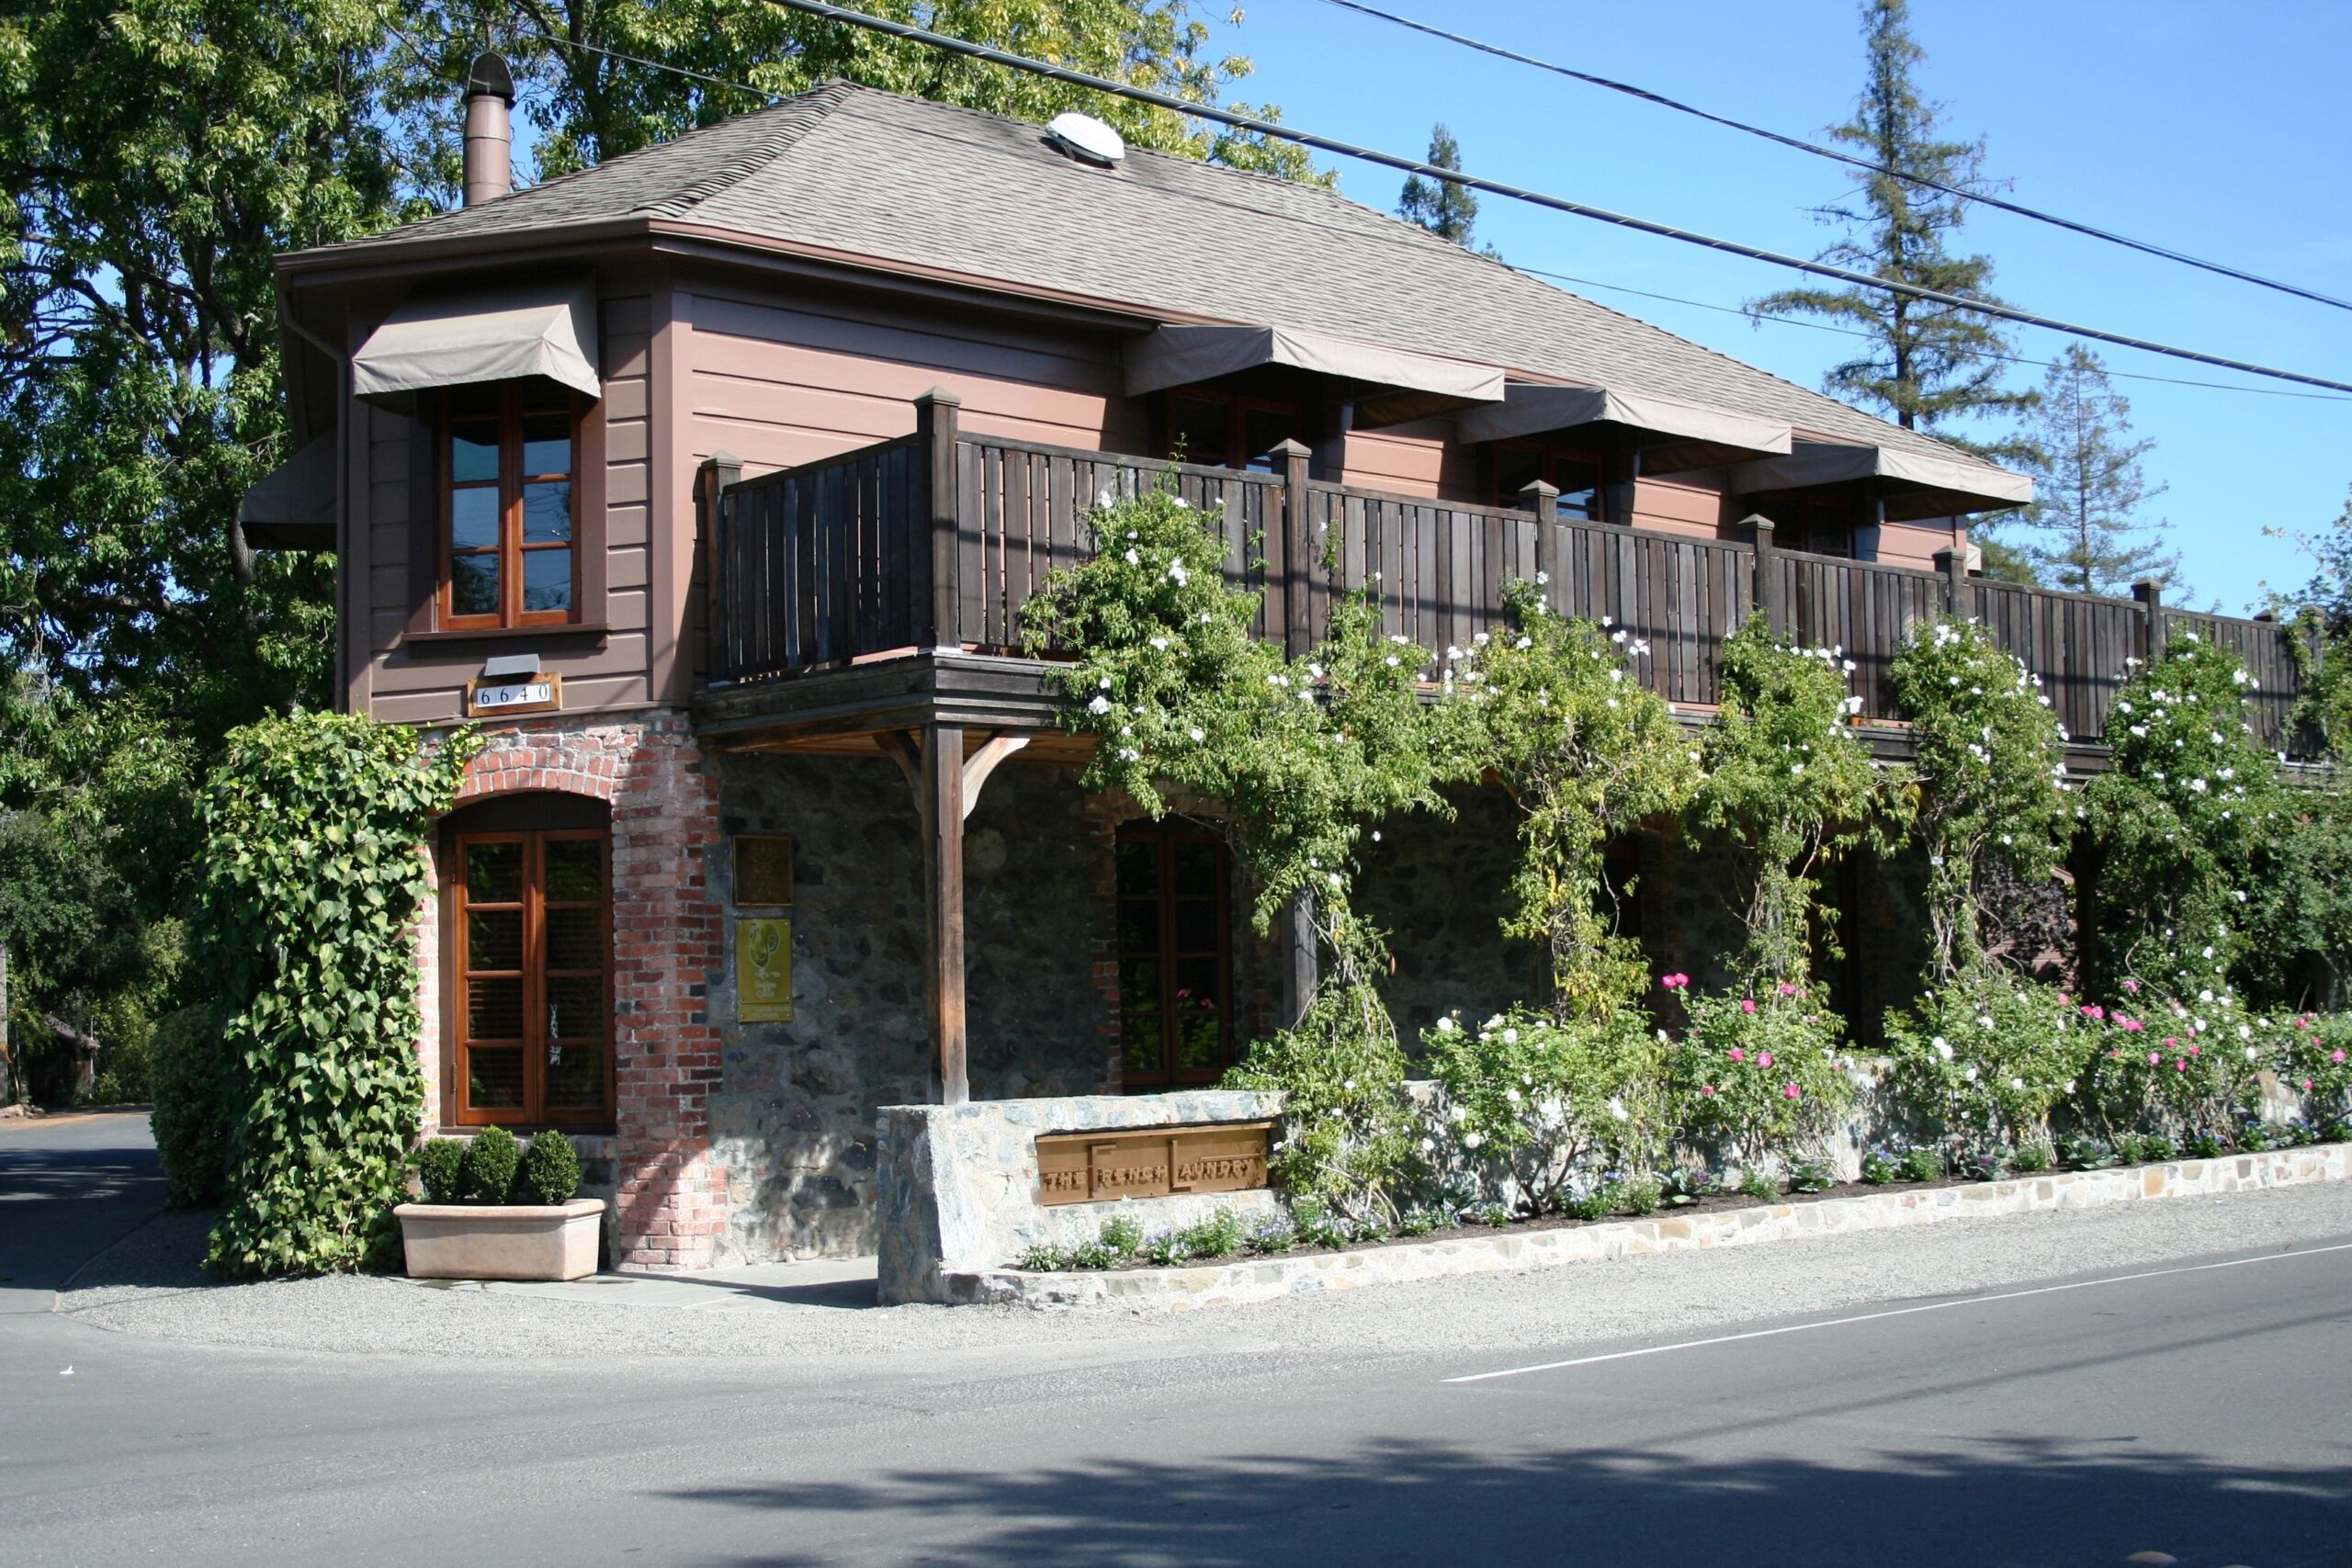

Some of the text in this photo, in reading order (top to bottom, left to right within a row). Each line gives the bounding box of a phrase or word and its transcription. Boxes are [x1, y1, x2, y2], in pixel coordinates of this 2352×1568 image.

[481, 682, 548, 705] 6640
[1045, 1139, 1255, 1192] THE FRENCH LAUNDRY
